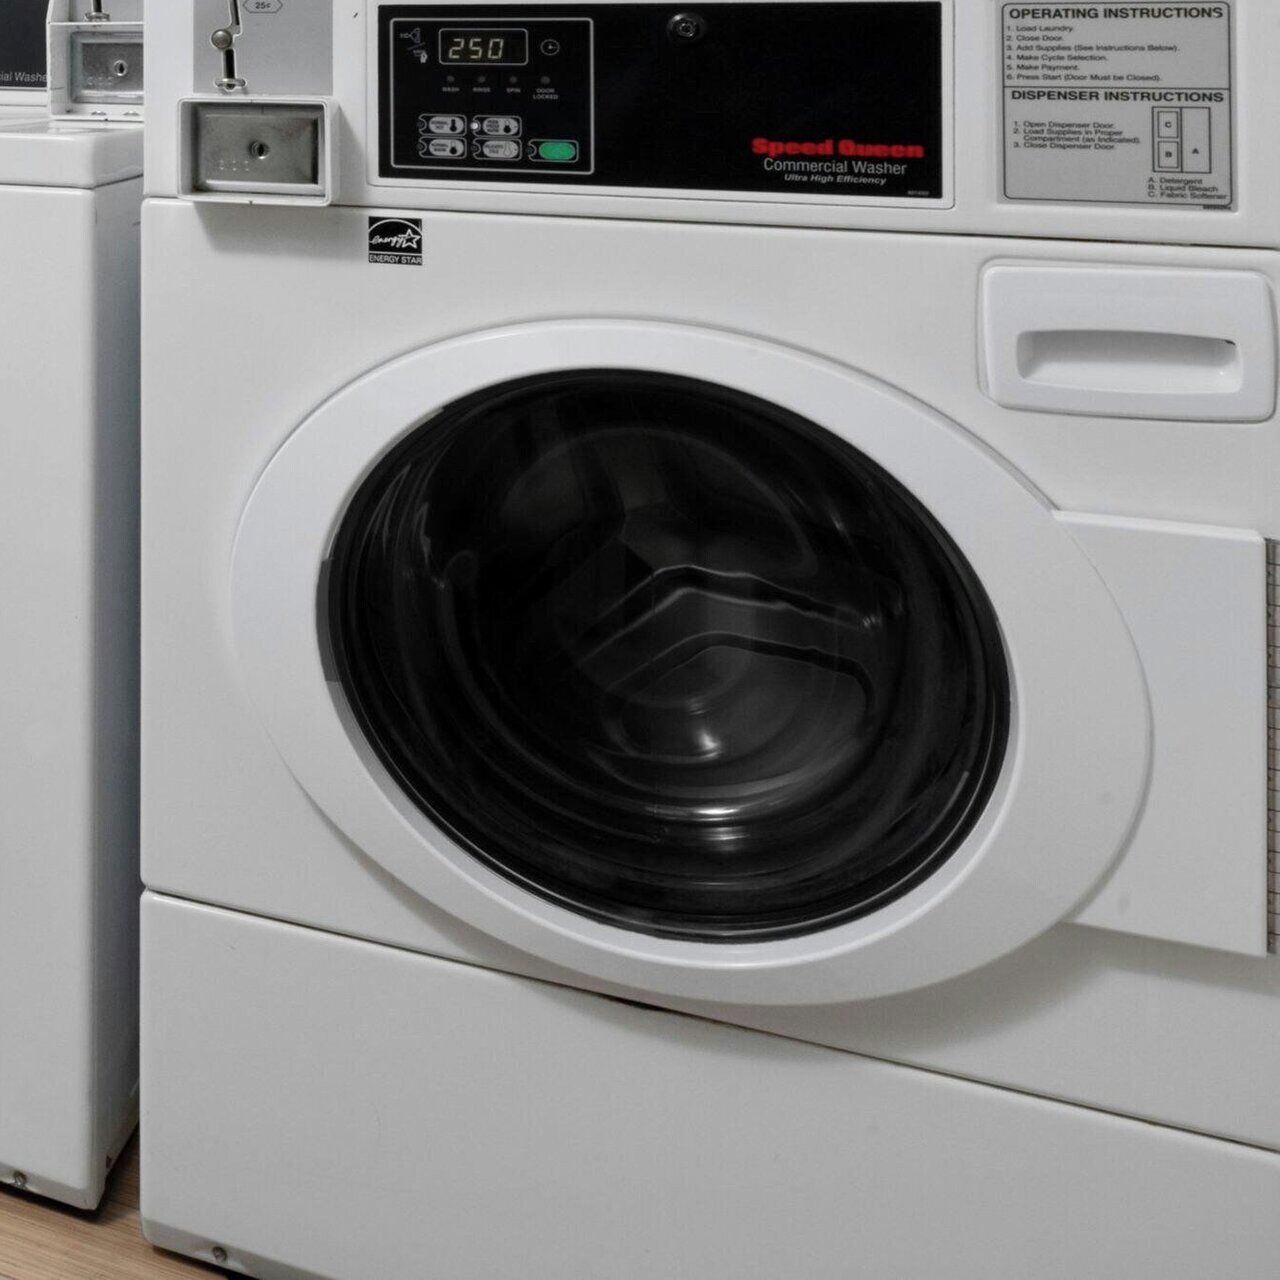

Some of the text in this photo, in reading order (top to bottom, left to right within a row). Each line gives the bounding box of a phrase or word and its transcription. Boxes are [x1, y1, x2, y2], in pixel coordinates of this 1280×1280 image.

[1009, 6, 1224, 20] OPERATING INSTRUCTIONS
[448, 38, 504, 60] 250
[1035, 44, 1072, 52] Supplies
[1074, 44, 1094, 52] (See
[1041, 54, 1065, 62] Cycle
[15, 72, 48, 82] Washe
[1064, 73, 1088, 81] (Door
[1011, 90, 1224, 102] DISPENSER INSTRUCTIONS
[1048, 121, 1090, 129] Dispenser
[1164, 121, 1173, 129] C
[1095, 129, 1123, 137] Proper
[1023, 135, 1080, 143] Compartment
[752, 138, 925, 158] Speed Queen
[1049, 142, 1092, 150] Dispenser
[1191, 147, 1200, 155] A
[763, 157, 907, 175] Commercial Washer
[784, 173, 887, 186] Ultra High Efficiency
[1159, 177, 1203, 185] Detergent
[1189, 192, 1228, 200] Softener
[369, 254, 423, 265] ENERGY STAR
